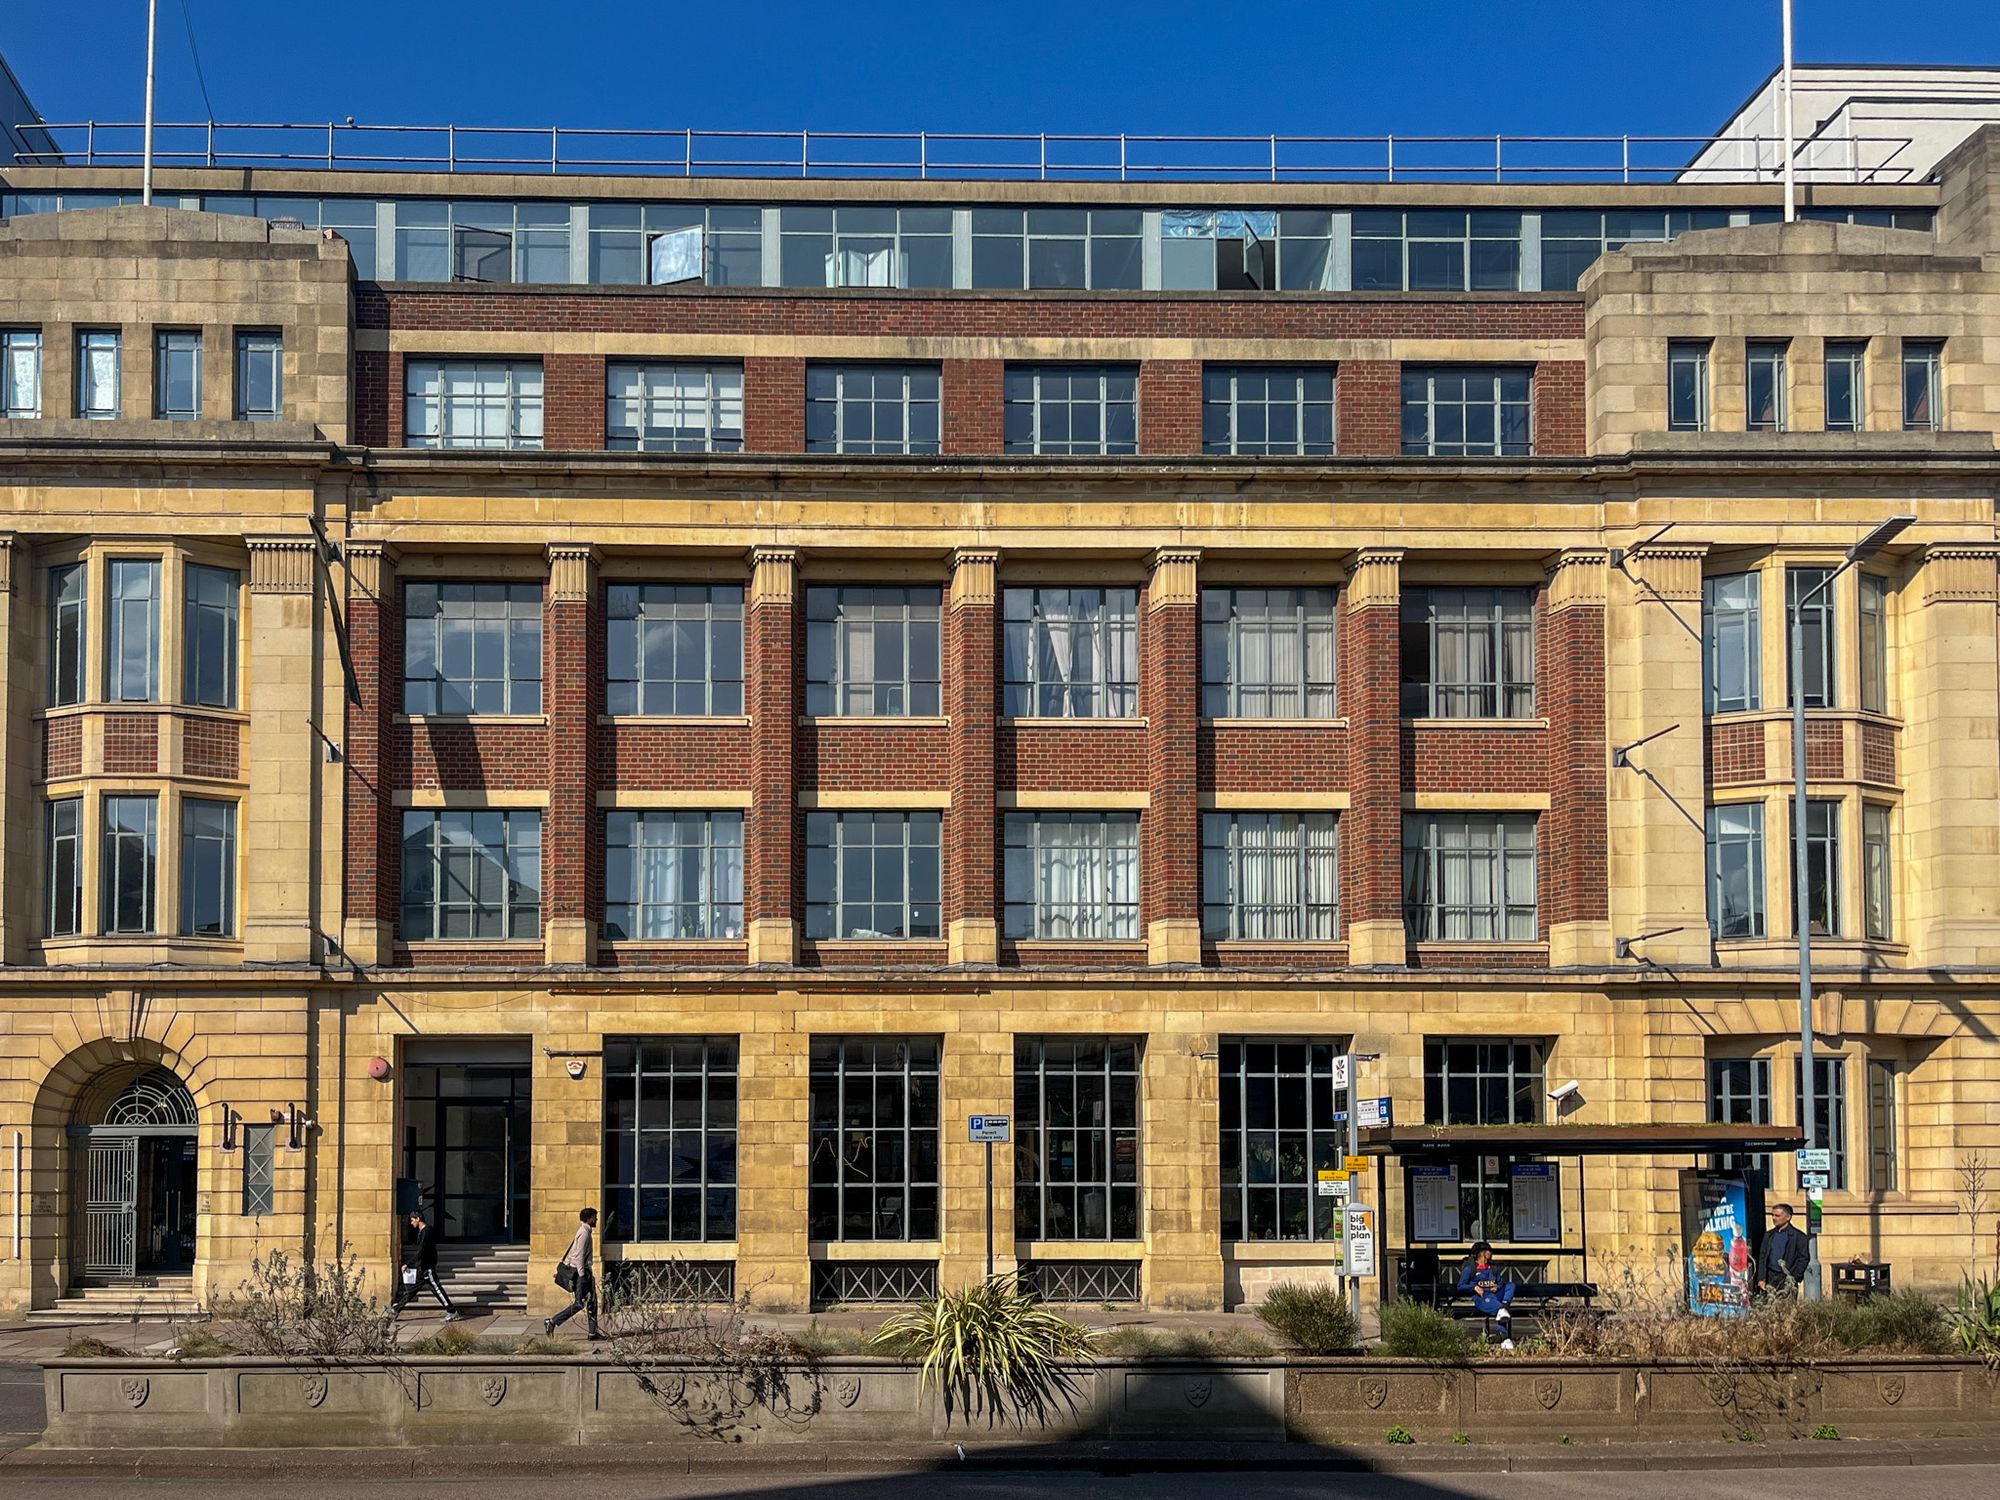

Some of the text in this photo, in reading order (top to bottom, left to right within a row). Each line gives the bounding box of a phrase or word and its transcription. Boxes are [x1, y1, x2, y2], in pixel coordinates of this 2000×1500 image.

[973, 1119, 981, 1129] P
[1350, 1215, 1364, 1224] big
[1350, 1231, 1370, 1241] plan
